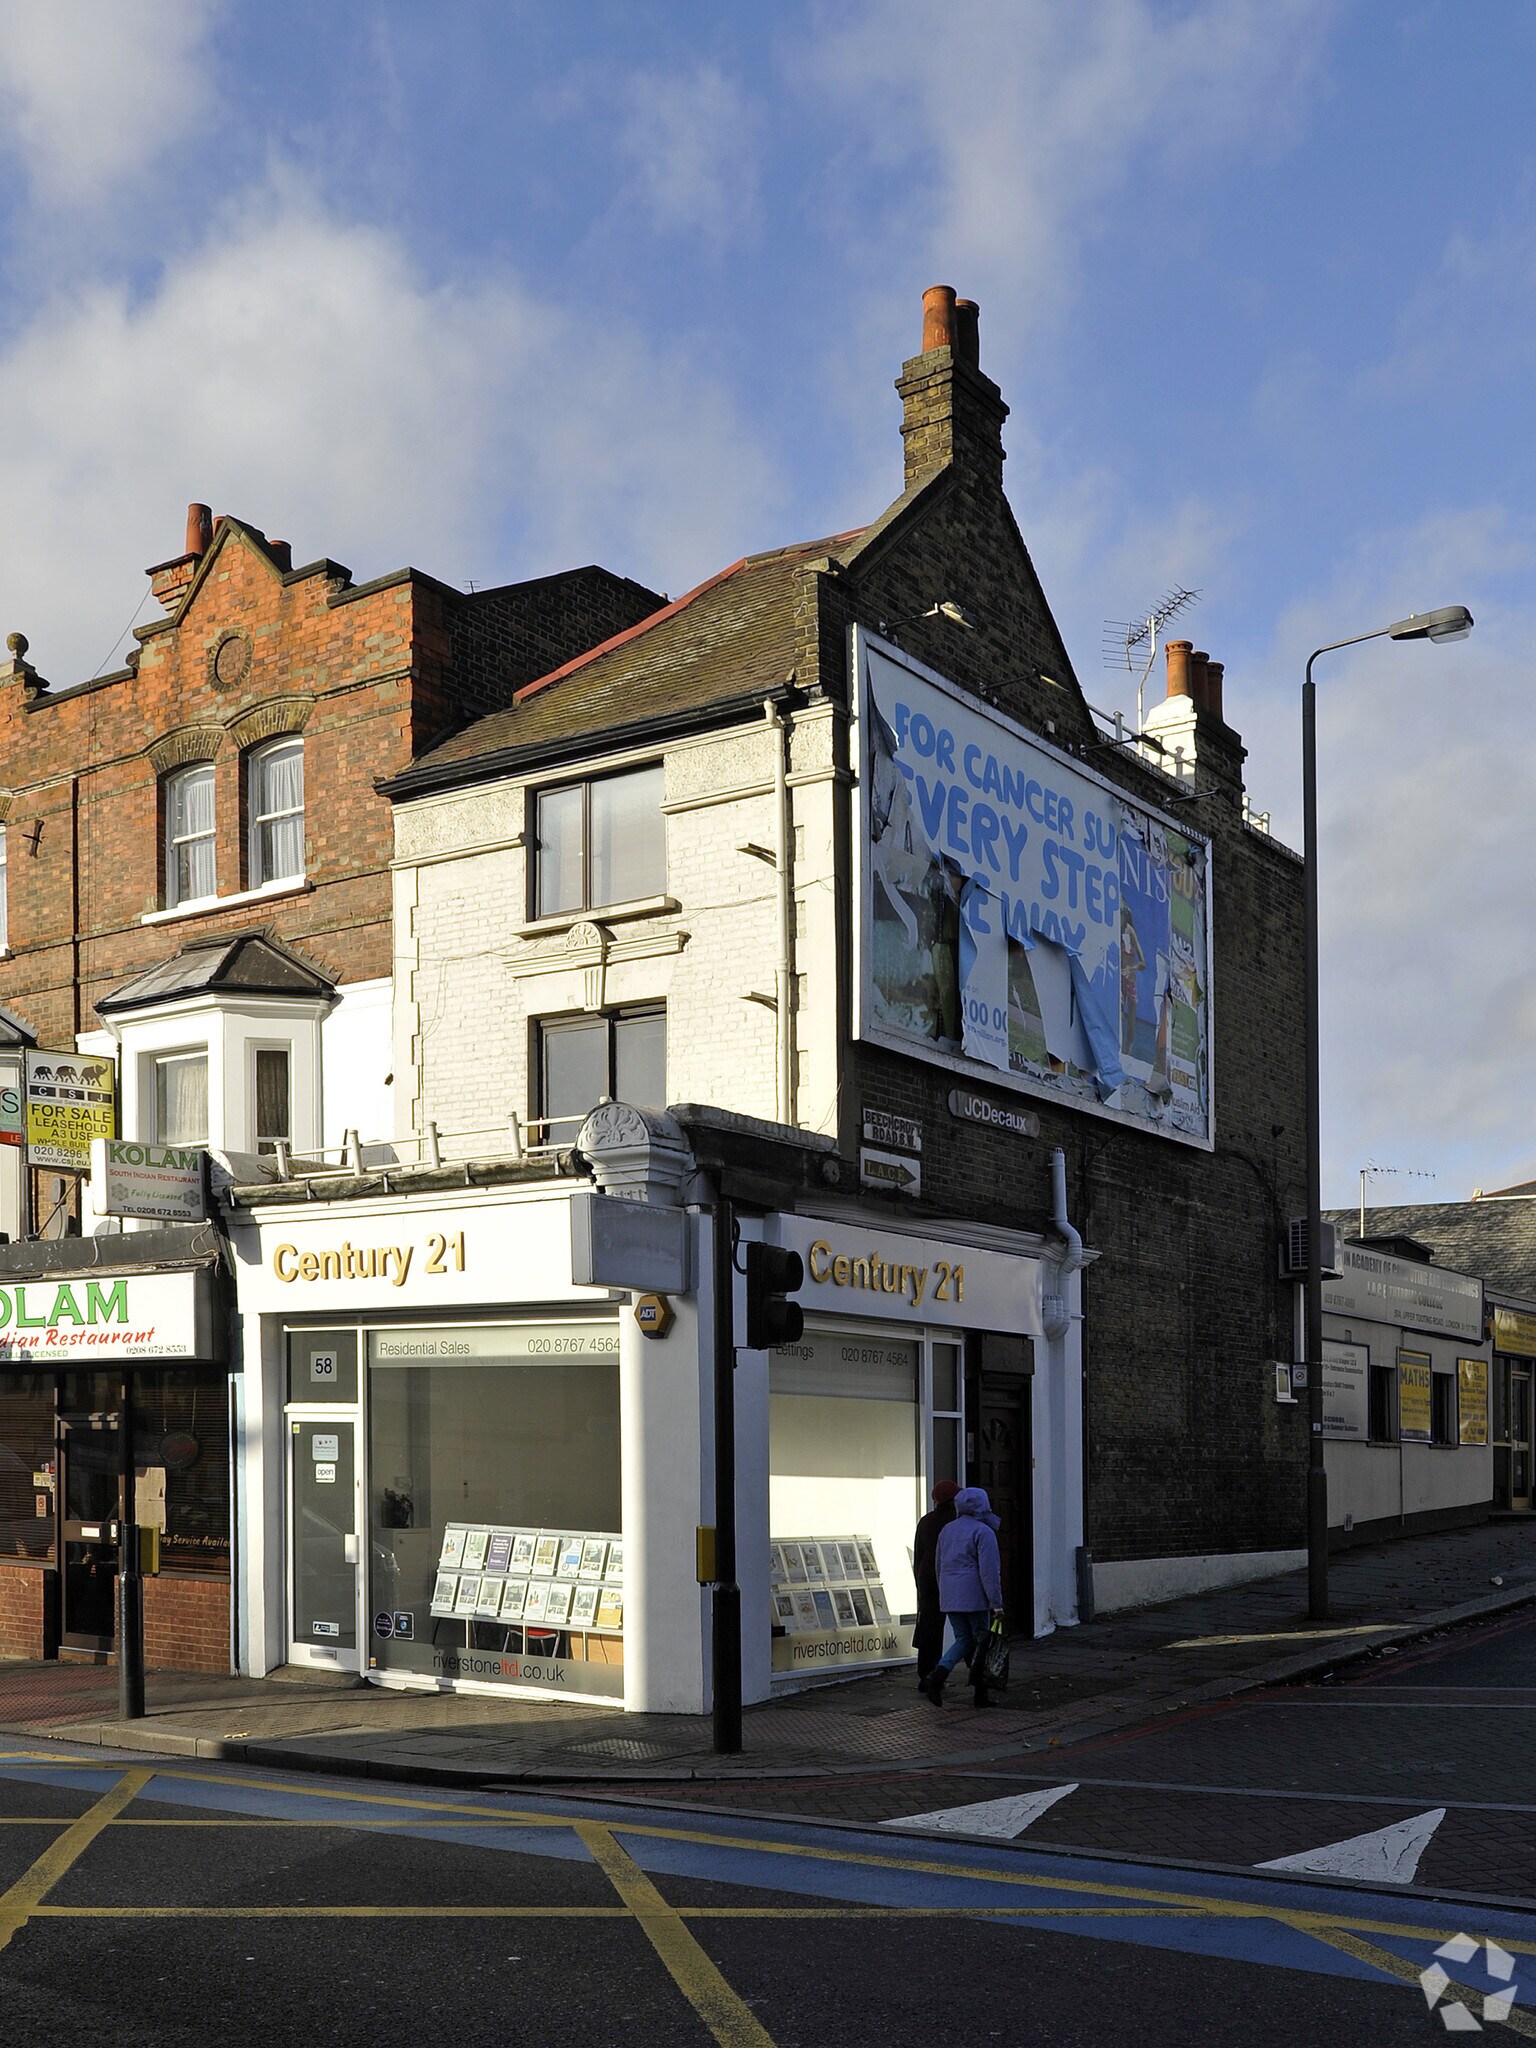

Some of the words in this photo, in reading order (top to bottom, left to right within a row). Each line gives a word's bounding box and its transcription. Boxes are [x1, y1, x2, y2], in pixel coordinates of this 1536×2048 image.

[895, 703, 955, 775] FOR
[964, 744, 1074, 840] CANCER
[1041, 839, 1120, 927] STEP
[31, 1104, 66, 1118] FOR
[71, 1107, 112, 1124] SALE
[964, 1096, 1027, 1132] JCDecaux
[35, 1118, 108, 1133] LEASEHOLD
[37, 1138, 67, 1148] WHOLE
[51, 1129, 67, 1139] A3
[70, 1132, 94, 1141] USE
[34, 1146, 54, 1156] 020
[56, 1147, 82, 1158] 8296
[109, 1144, 199, 1171] KOLAM
[131, 1189, 151, 1199] Fully
[152, 1192, 182, 1200] Licensed
[137, 1206, 156, 1215] 0208
[273, 1240, 415, 1287] Century
[424, 1231, 465, 1274] 21
[1351, 1252, 1382, 1275] ACADEMY
[1383, 1261, 1391, 1274] OF
[809, 1239, 928, 1306] Century
[935, 1261, 965, 1303] 21
[640, 1308, 656, 1318] ADT
[45, 1327, 155, 1347] Restaurant
[26, 1349, 69, 1359] LICENSED
[126, 1347, 146, 1355] 0208
[148, 1346, 163, 1354] 672
[165, 1345, 187, 1354] 8553
[380, 1341, 437, 1356] Residential
[440, 1340, 470, 1355] Sales
[527, 1339, 551, 1353] 020
[554, 1338, 585, 1352] 8767
[589, 1338, 620, 1352] 4564
[315, 1357, 332, 1374] 58
[841, 1348, 860, 1362] 020
[861, 1349, 884, 1364] 8767
[886, 1352, 908, 1366] 4564
[1400, 1367, 1429, 1388] MATHS
[173, 1533, 200, 1545] Service
[793, 1632, 898, 1659] riverstoneltd.co.uk
[433, 1651, 565, 1682] riverstoneltd.co.uk
